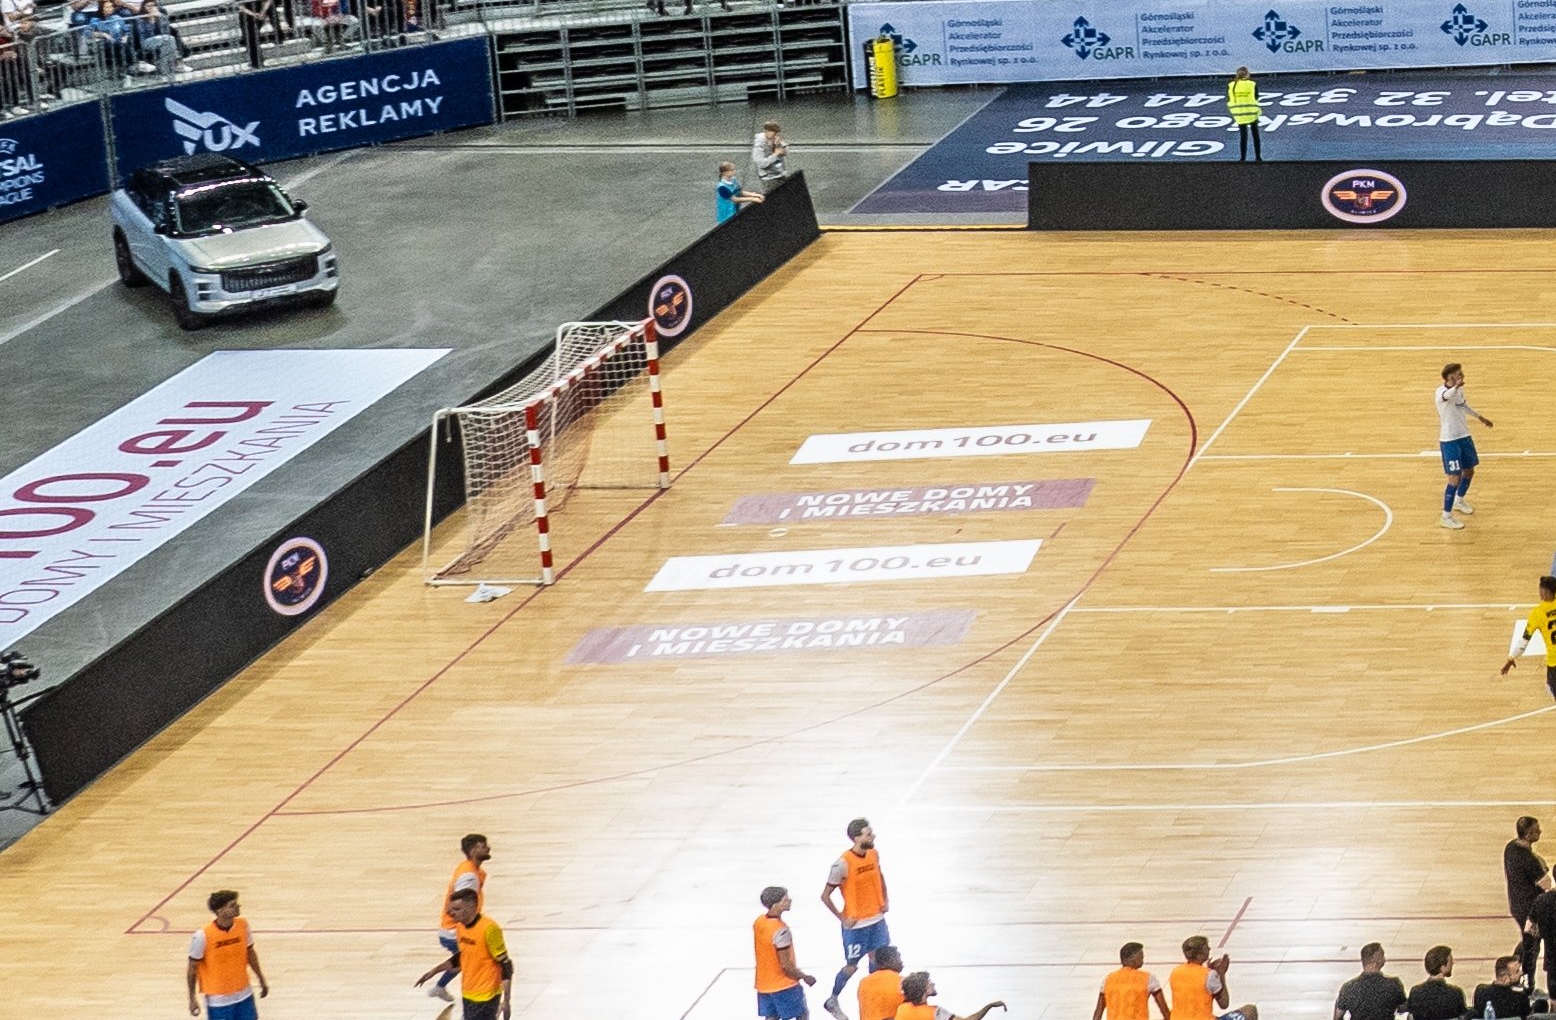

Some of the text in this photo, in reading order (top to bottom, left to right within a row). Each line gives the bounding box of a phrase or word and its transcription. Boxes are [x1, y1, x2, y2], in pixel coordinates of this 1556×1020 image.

[1283, 40, 1324, 54] GAPR
[1470, 32, 1510, 47] GAPR
[1093, 46, 1134, 61] GAPR
[1142, 49, 1186, 61] Rynkowej
[1332, 42, 1377, 54] Rynkowej
[296, 68, 441, 109] AGENCJA
[1045, 95, 1128, 108] 44
[1144, 95, 1226, 108] 44
[1374, 90, 1451, 106] 32
[299, 95, 444, 137] REKLAMY
[1013, 116, 1099, 133] 26
[986, 140, 1225, 158] Gliwice
[1352, 180, 1375, 189] PKM
[848, 433, 1098, 454] dom100.eu
[108, 399, 352, 530] MIESZKANIA
[1448, 460, 1460, 472] 31
[796, 484, 1036, 507] NOWE DOMY
[802, 495, 1033, 519] MIESZKANIA
[708, 555, 983, 580] dom100.eu
[647, 616, 910, 642] NOWE DOMY
[652, 630, 907, 656] MIESZKANIA
[848, 943, 861, 959] 12
